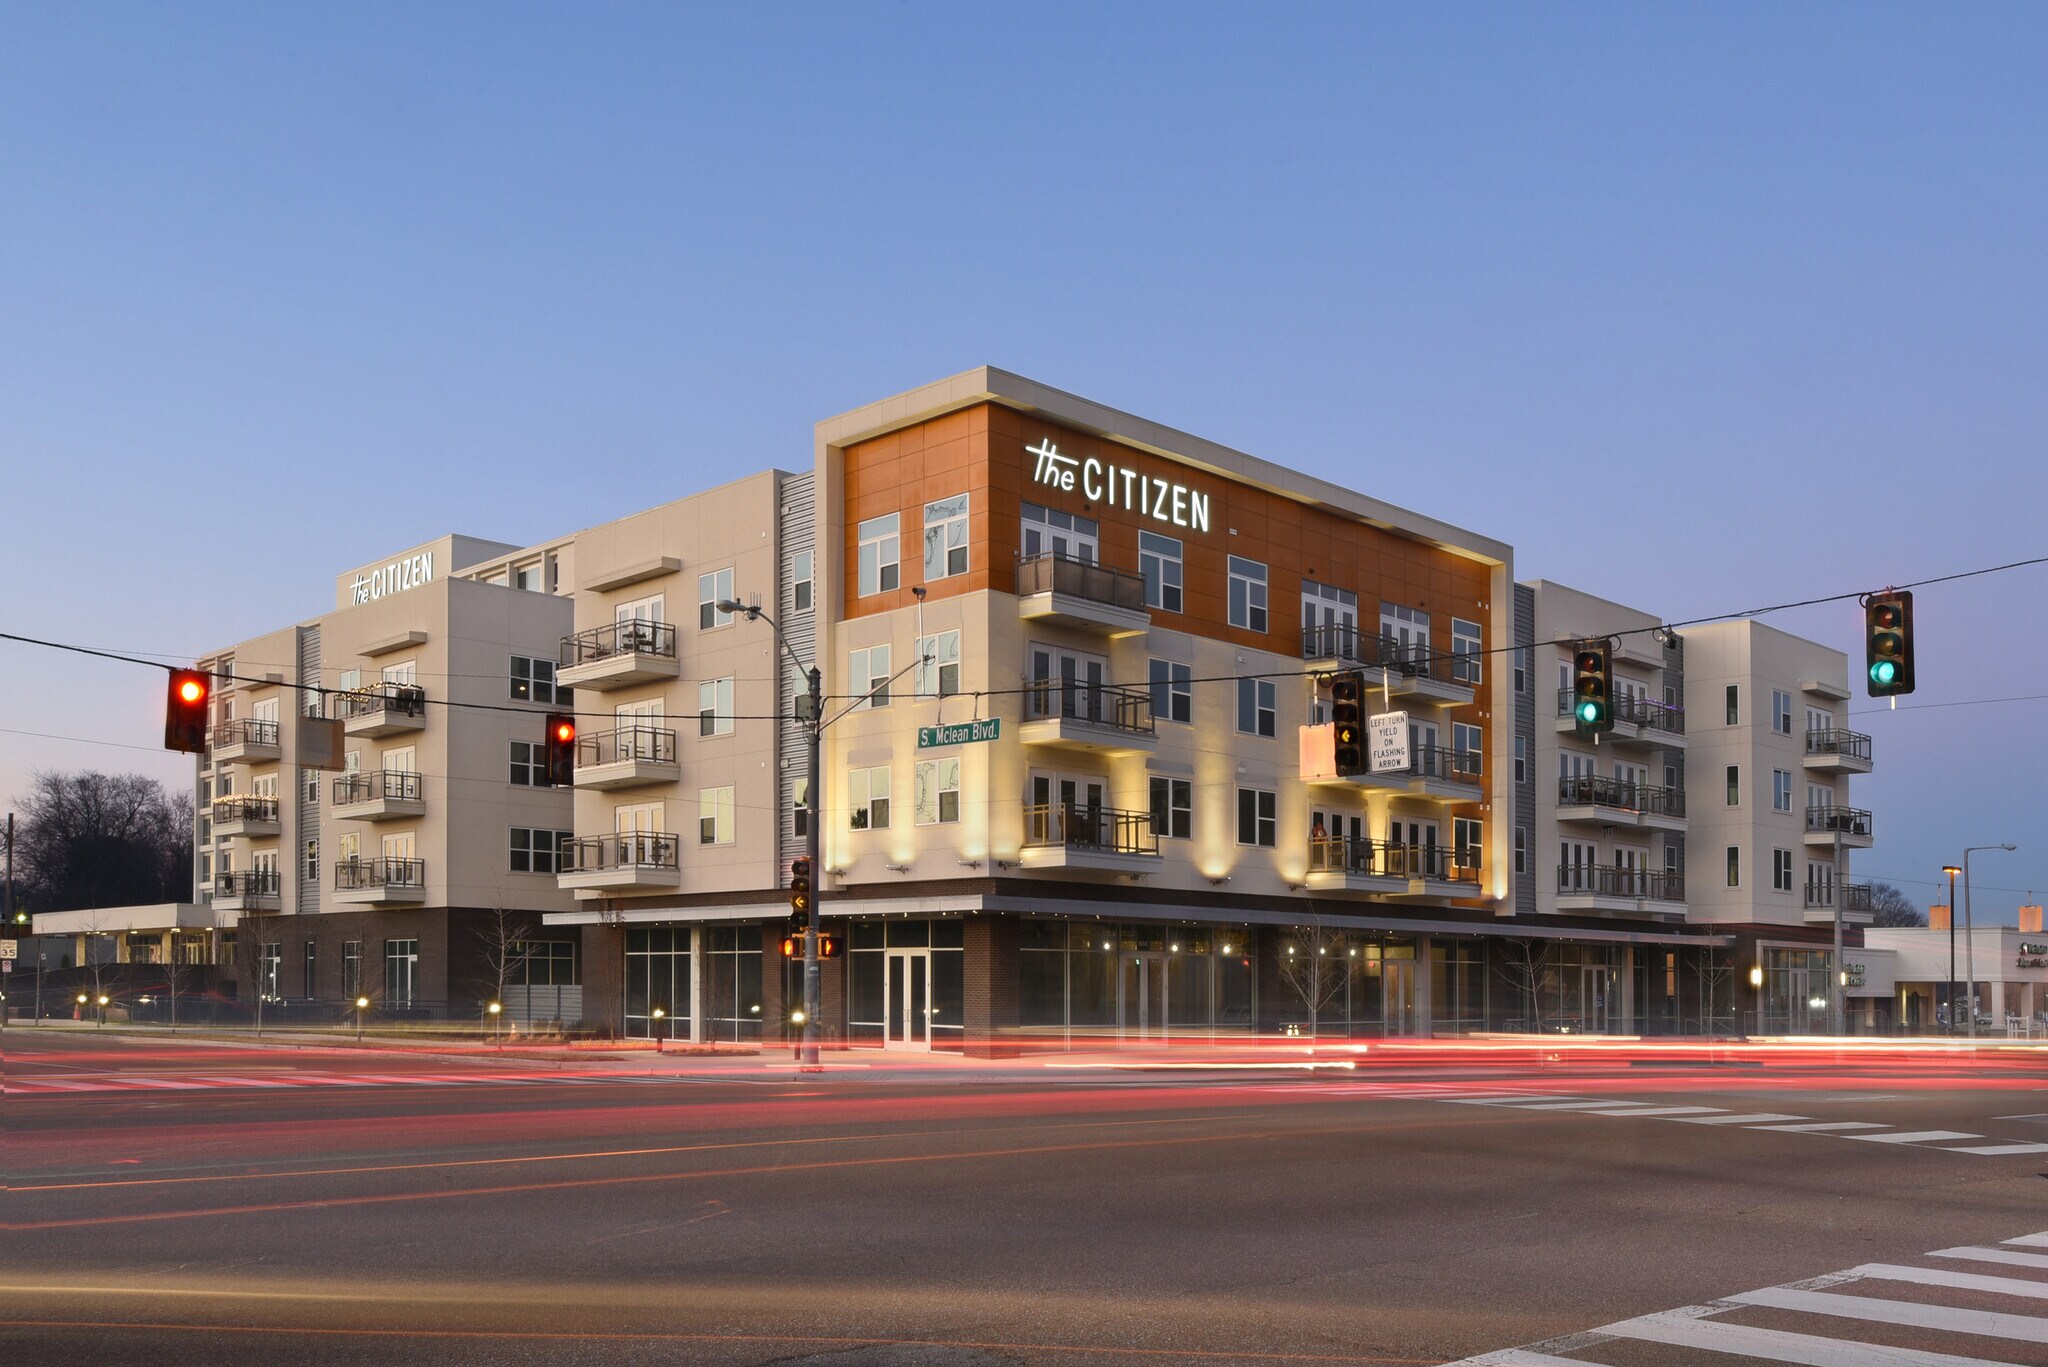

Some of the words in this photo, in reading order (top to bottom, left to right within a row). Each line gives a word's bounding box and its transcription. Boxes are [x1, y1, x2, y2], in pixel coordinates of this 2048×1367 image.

[1025, 438, 1079, 491] the
[1083, 458, 1209, 532] CITIZEN
[350, 574, 372, 606] the
[372, 551, 433, 600] CITIZEN
[1370, 718, 1385, 728] LEFT
[1388, 716, 1405, 726] TURN
[921, 729, 930, 746] S.
[935, 727, 969, 745] Mclean
[972, 721, 997, 741] Blvd.
[1378, 727, 1398, 737] YIELD
[1384, 738, 1394, 747] ON
[1373, 747, 1406, 759] FLASHING
[1378, 759, 1402, 769] ARROW
[1, 949, 16, 957] 35
